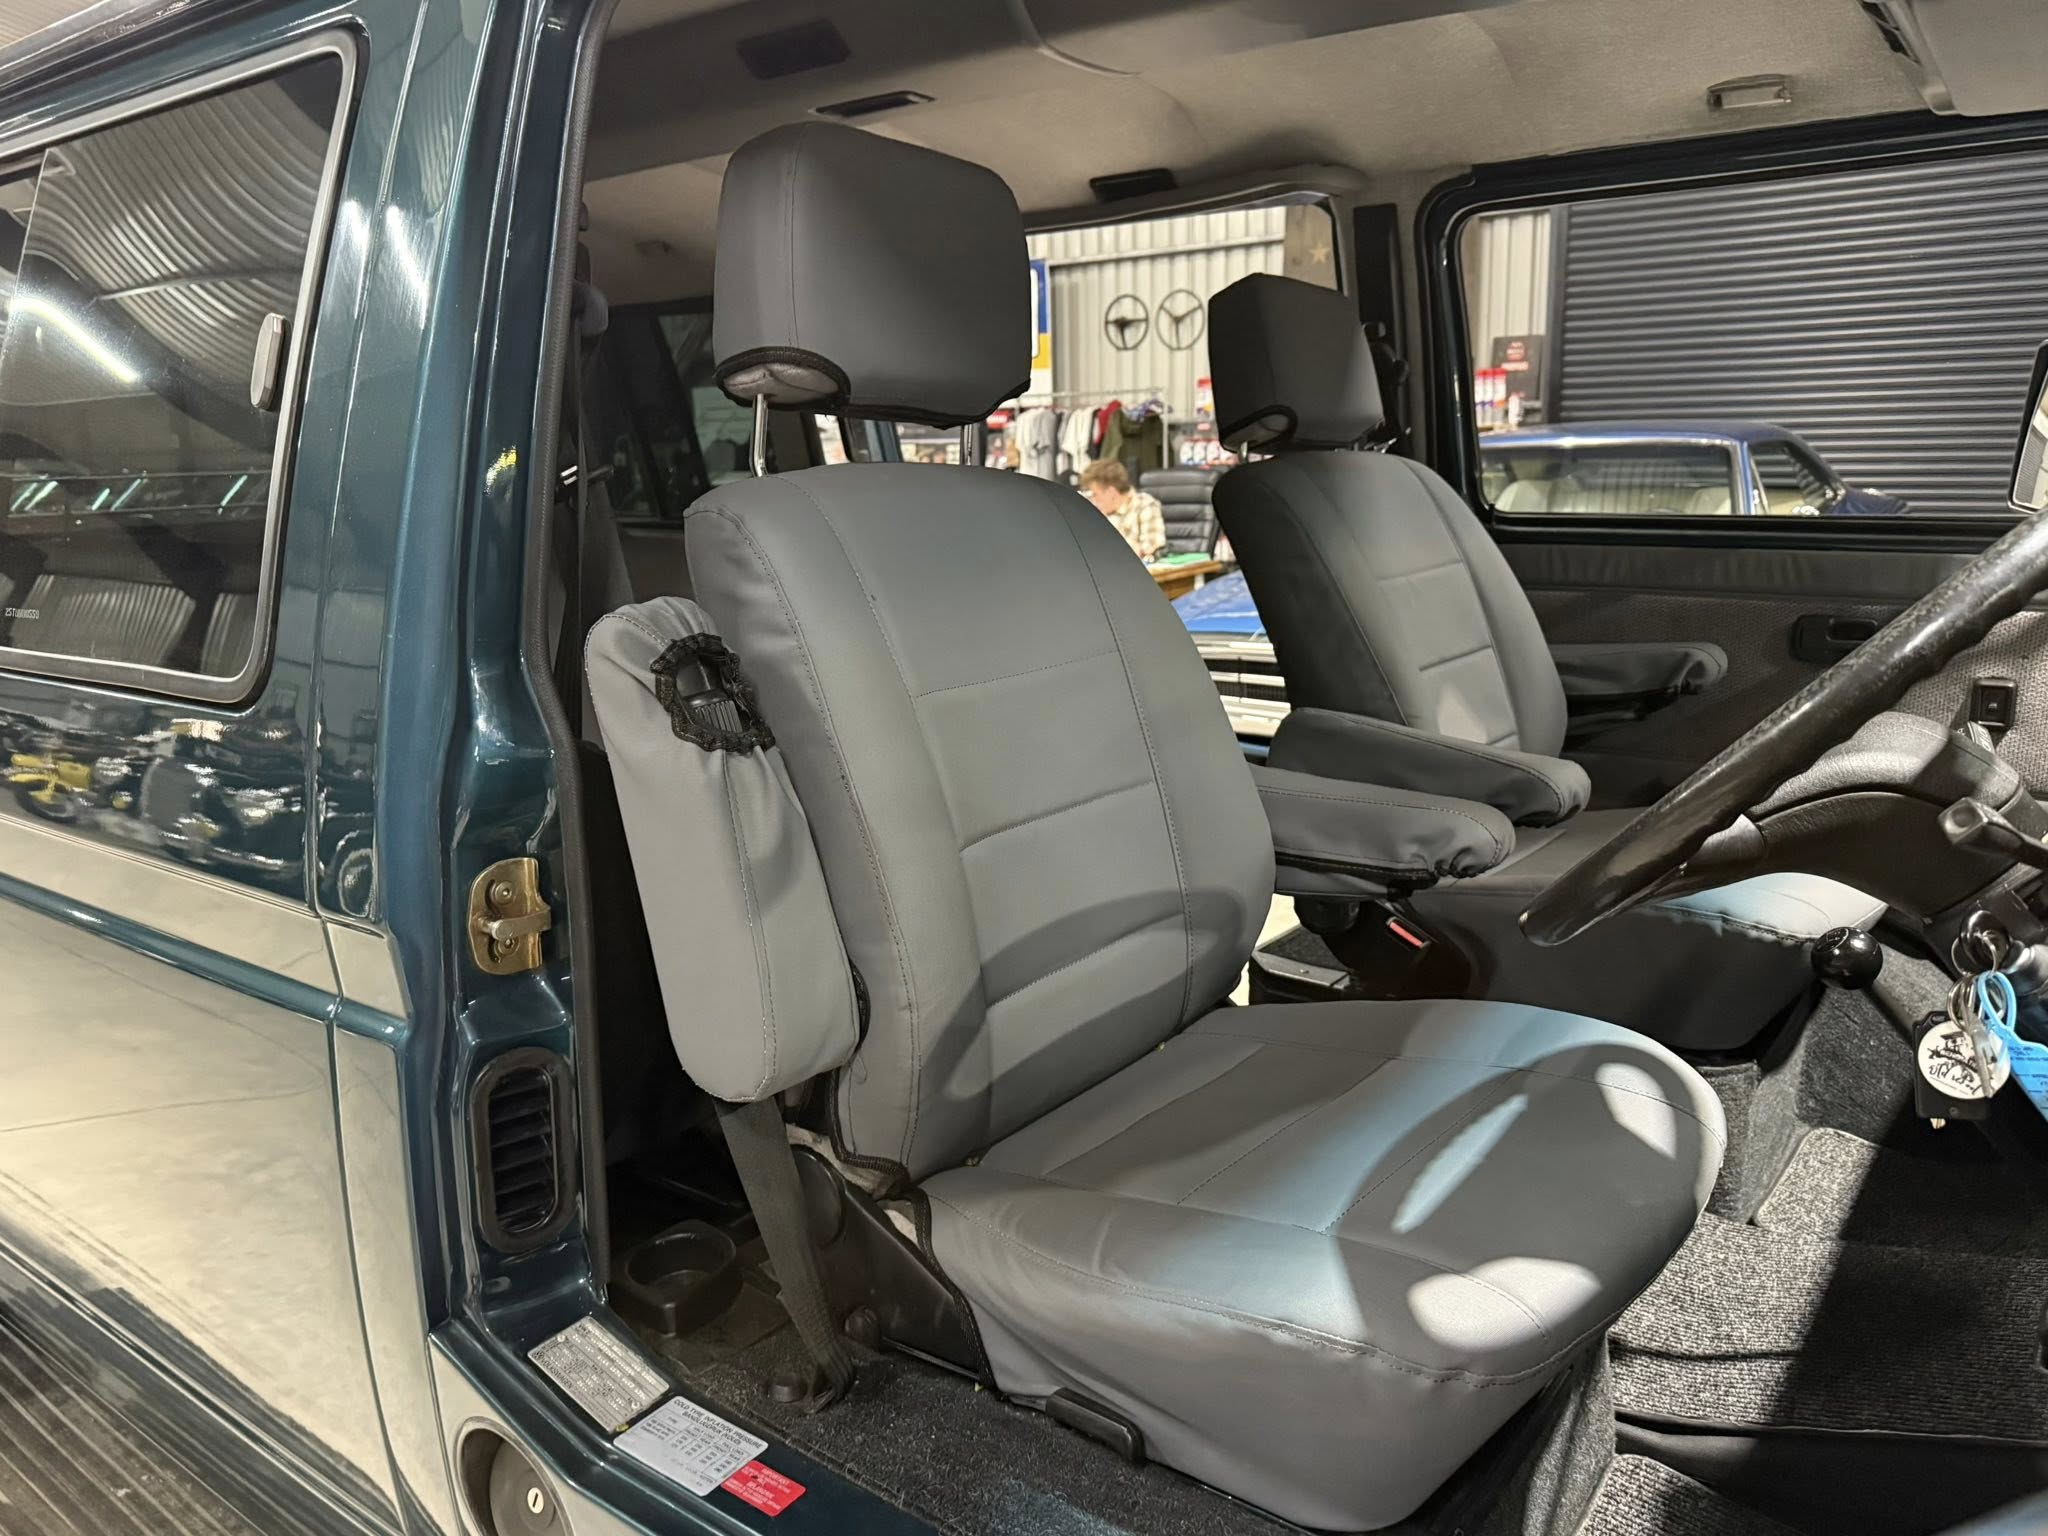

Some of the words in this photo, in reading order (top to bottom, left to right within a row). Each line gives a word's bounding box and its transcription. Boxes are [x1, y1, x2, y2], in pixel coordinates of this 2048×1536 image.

[672, 1398, 691, 1410] COLD
[702, 1414, 734, 1433] INFLATION
[731, 1430, 763, 1449] PRESSURE
